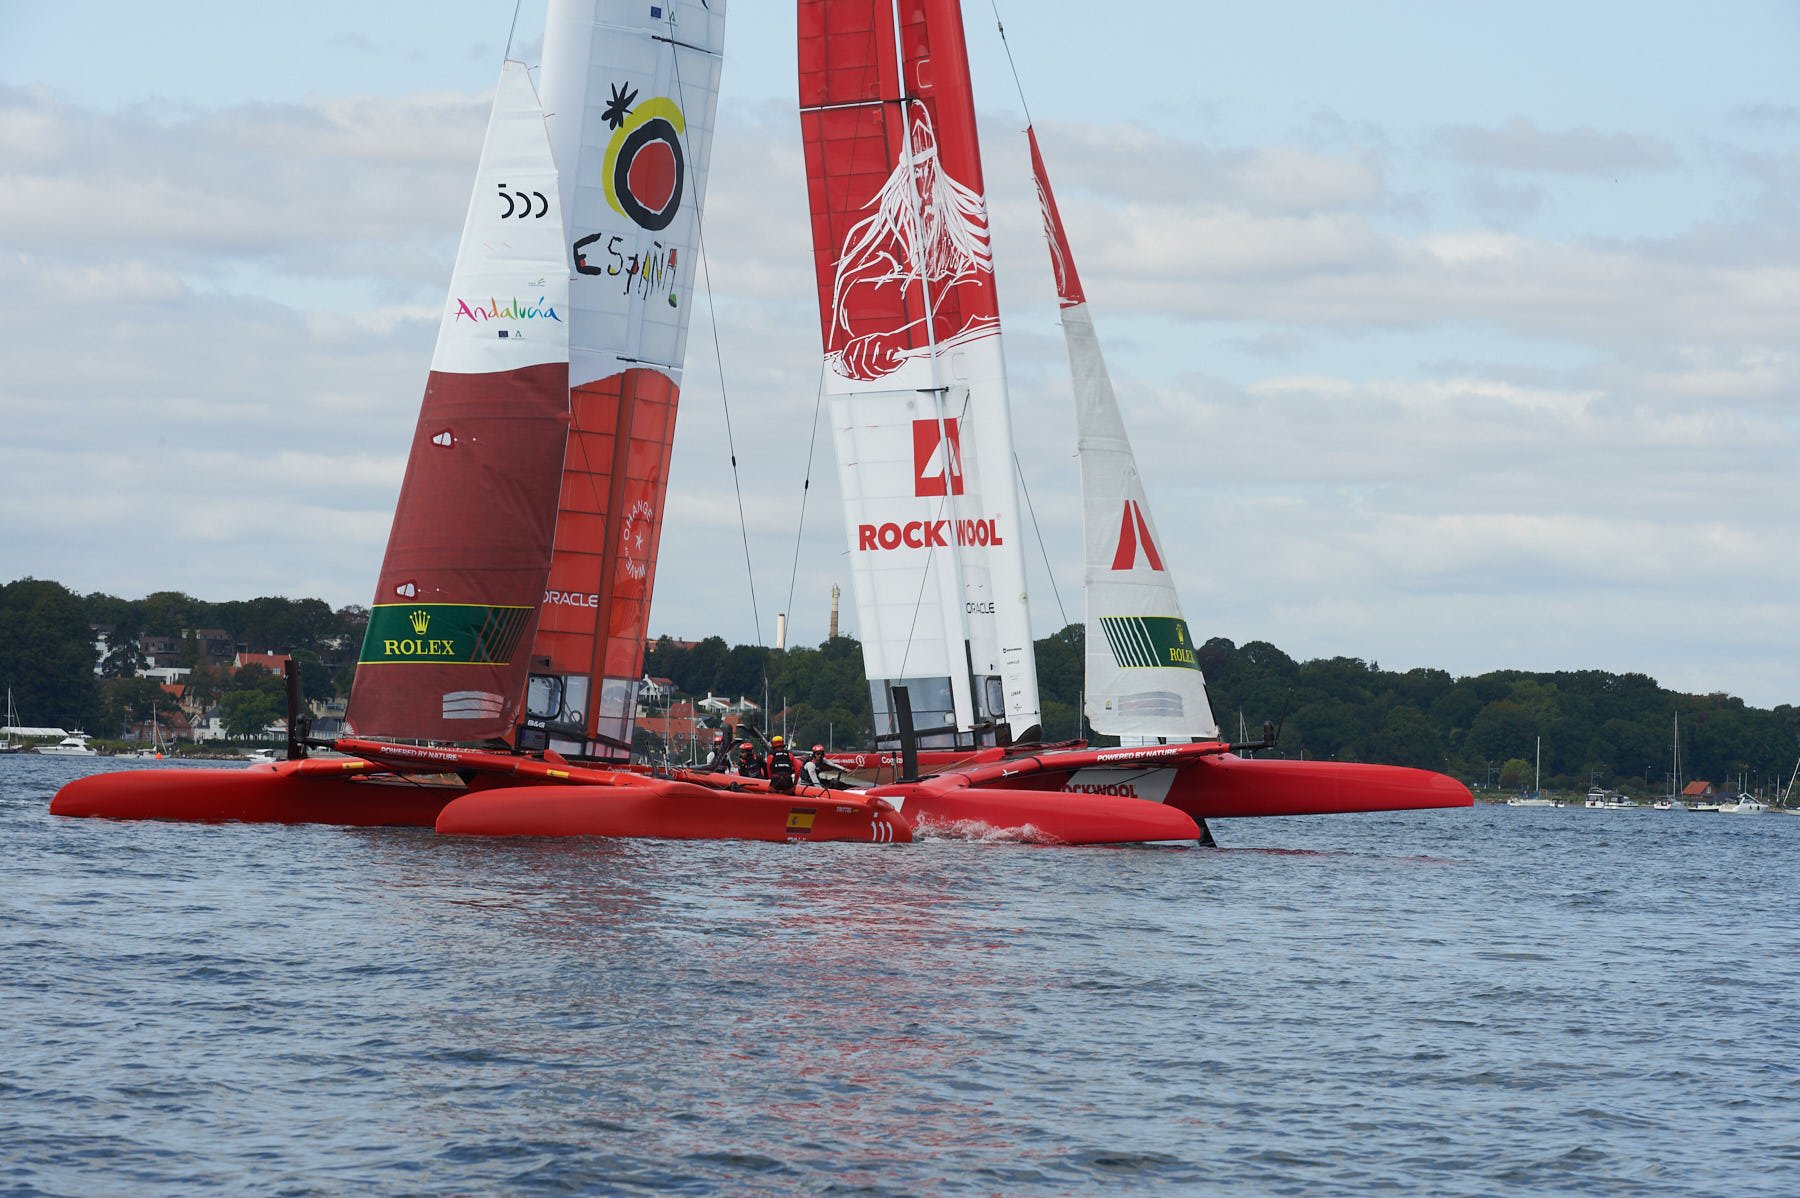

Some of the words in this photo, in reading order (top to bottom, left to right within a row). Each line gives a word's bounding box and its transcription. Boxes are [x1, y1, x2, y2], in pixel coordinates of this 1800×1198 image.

[455, 296, 562, 322] Andalucía
[858, 518, 1003, 551] ROCKWOOL
[384, 639, 455, 655] ROLEX
[527, 719, 546, 729] B&G
[380, 746, 418, 757] POWERED
[417, 750, 428, 758] BY
[1096, 751, 1135, 761] POWERED
[1135, 750, 1145, 758] BY
[1061, 784, 1138, 798] OCKWOOL
